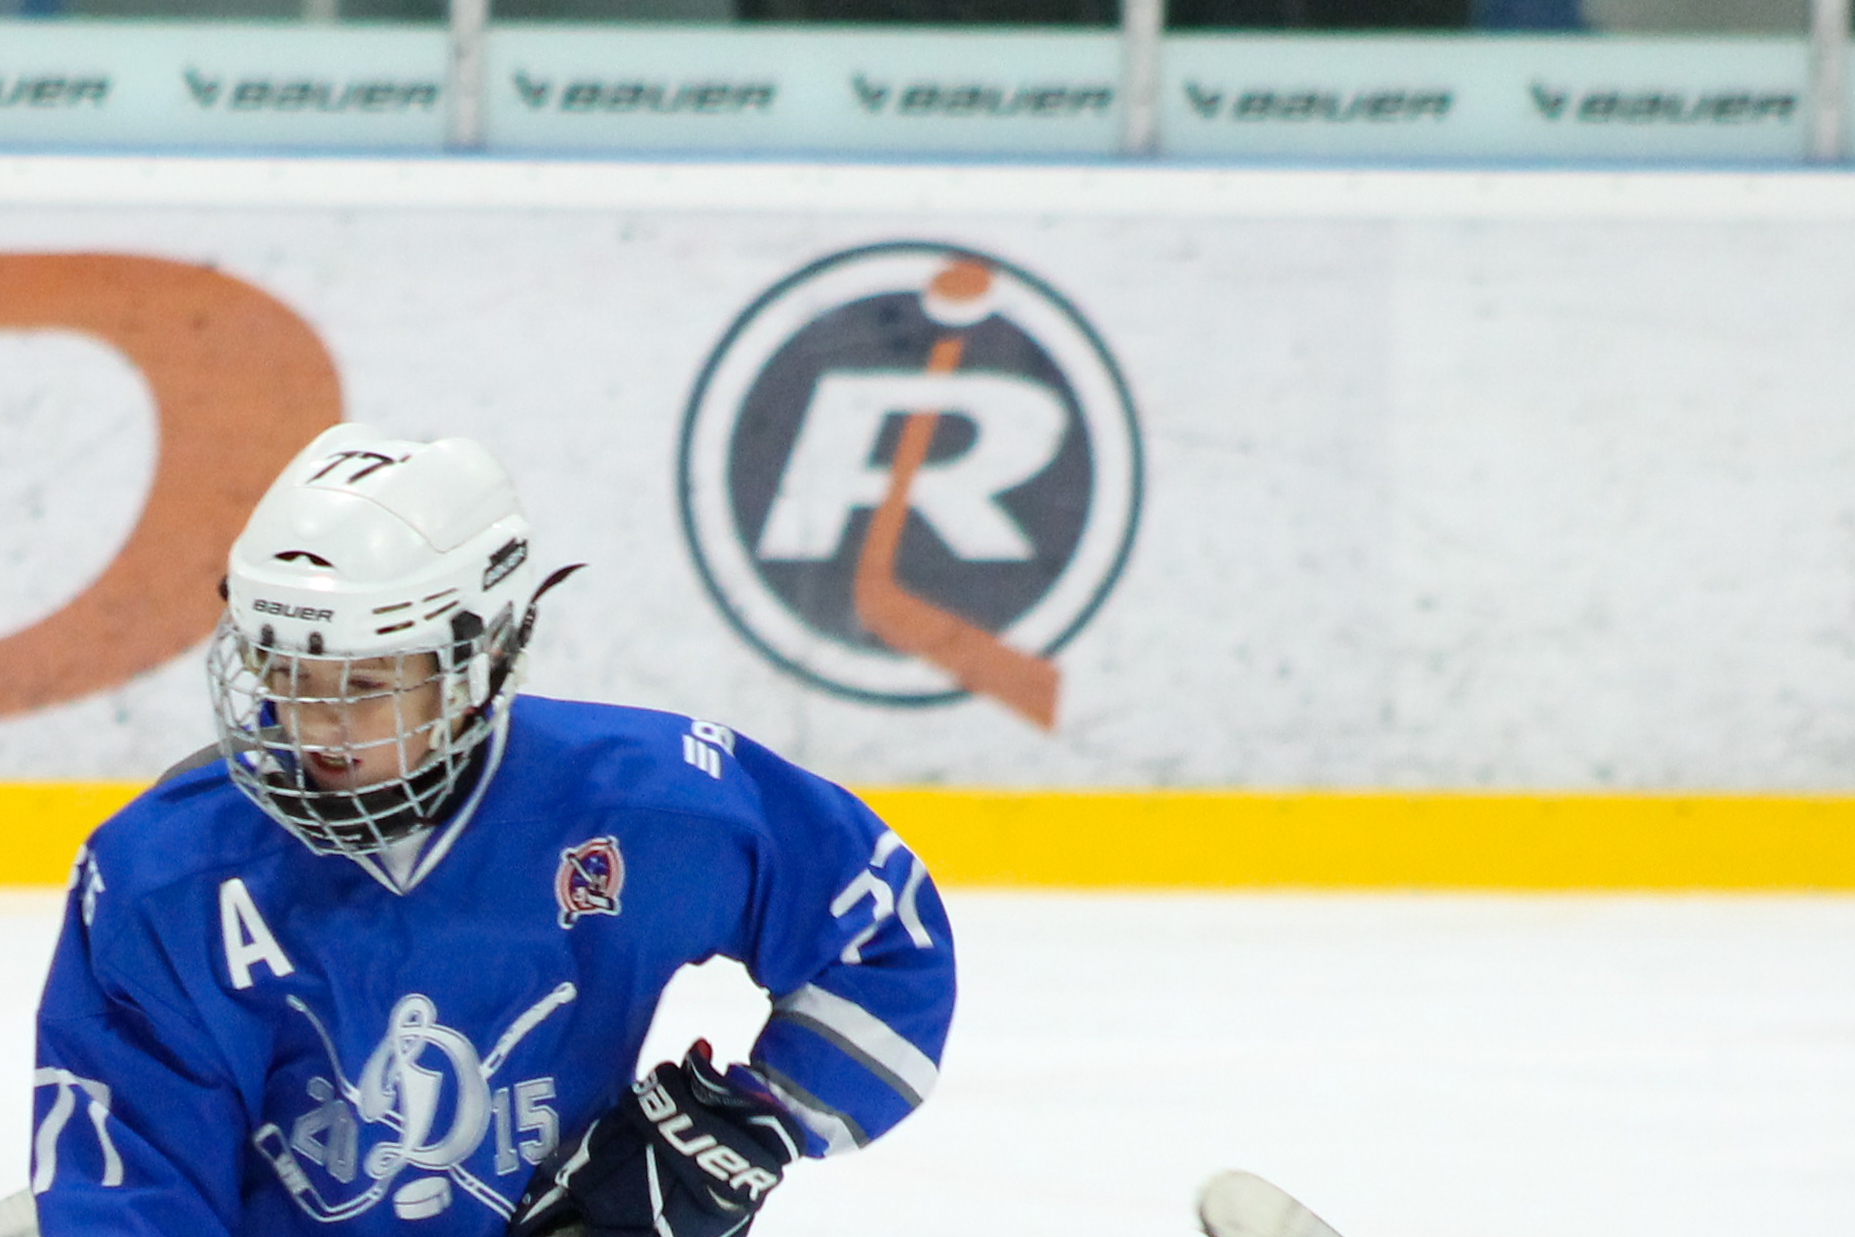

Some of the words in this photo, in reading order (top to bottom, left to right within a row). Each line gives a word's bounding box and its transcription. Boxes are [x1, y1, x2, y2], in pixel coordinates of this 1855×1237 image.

[252, 598, 335, 623] BAUER
[218, 876, 296, 991] A
[491, 1075, 561, 1177] 15
